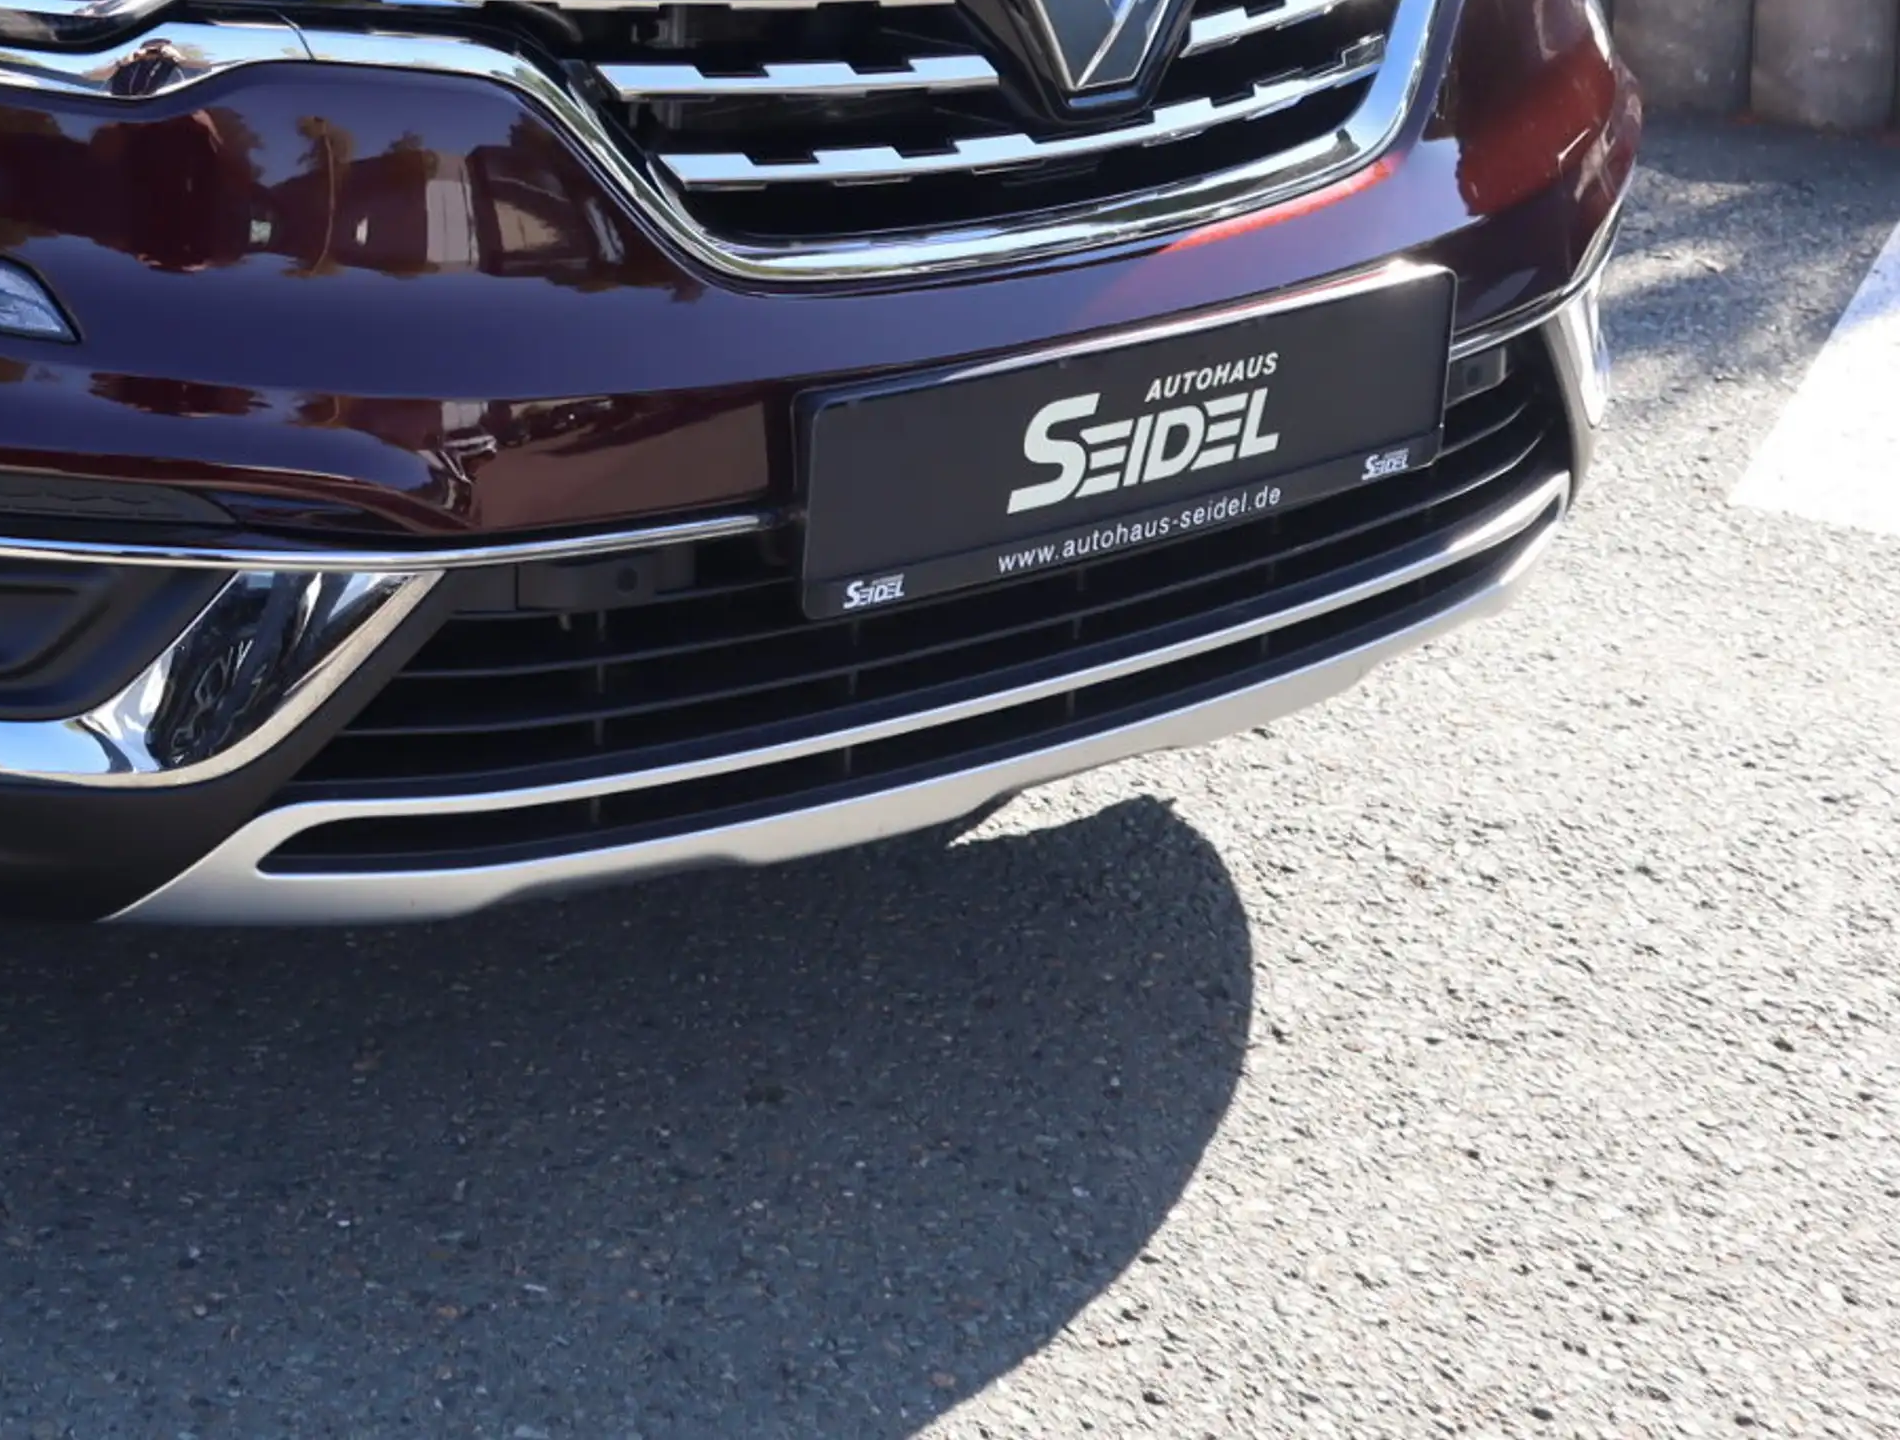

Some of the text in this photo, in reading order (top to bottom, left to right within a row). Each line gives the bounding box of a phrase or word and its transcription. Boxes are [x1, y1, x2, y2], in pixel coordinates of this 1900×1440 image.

[1144, 351, 1280, 403] AUTOHAUS
[1006, 387, 1280, 514] SEIDEL
[997, 485, 1282, 573] www.autohaus-seidel.de
